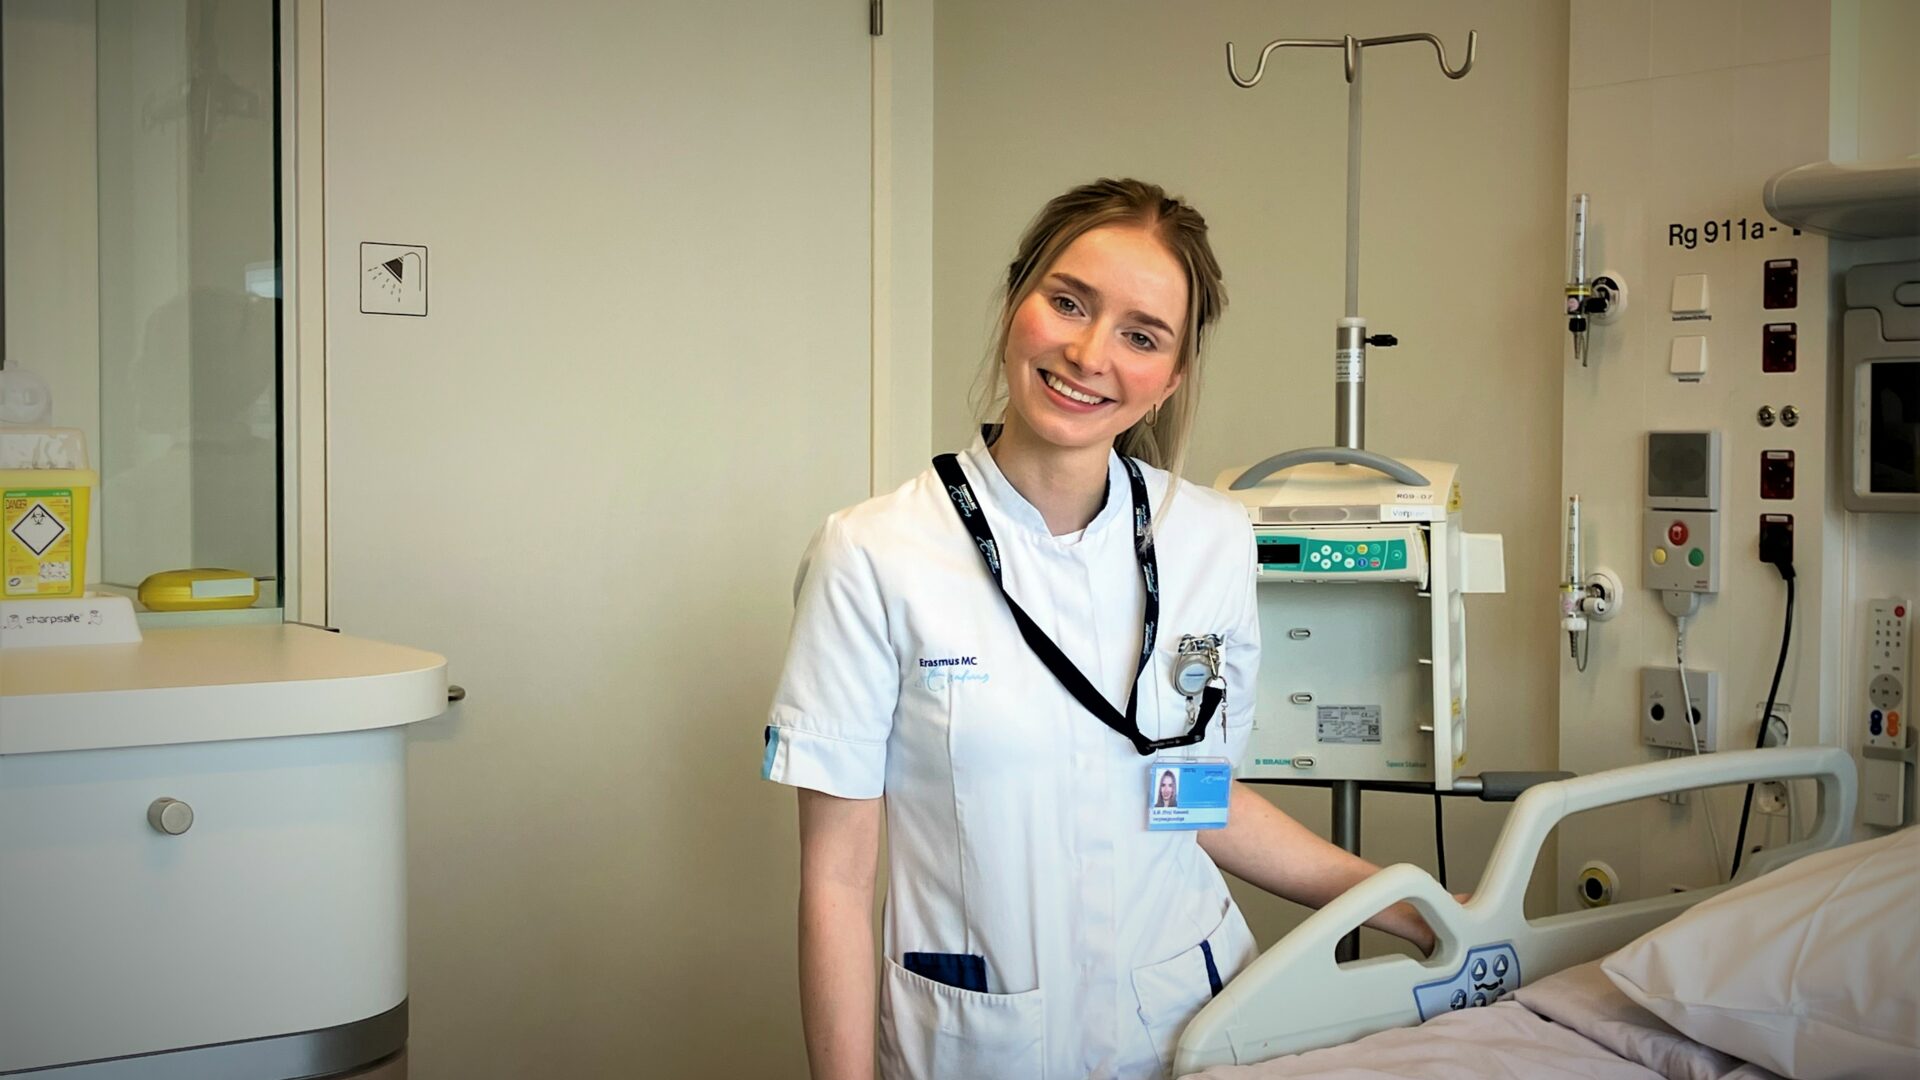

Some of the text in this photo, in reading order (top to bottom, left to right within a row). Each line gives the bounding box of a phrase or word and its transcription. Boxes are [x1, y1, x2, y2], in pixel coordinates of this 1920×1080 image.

[1669, 223, 1697, 249] Rg
[25, 613, 81, 625] sharpsafe
[918, 656, 978, 668] Erasmus MC
